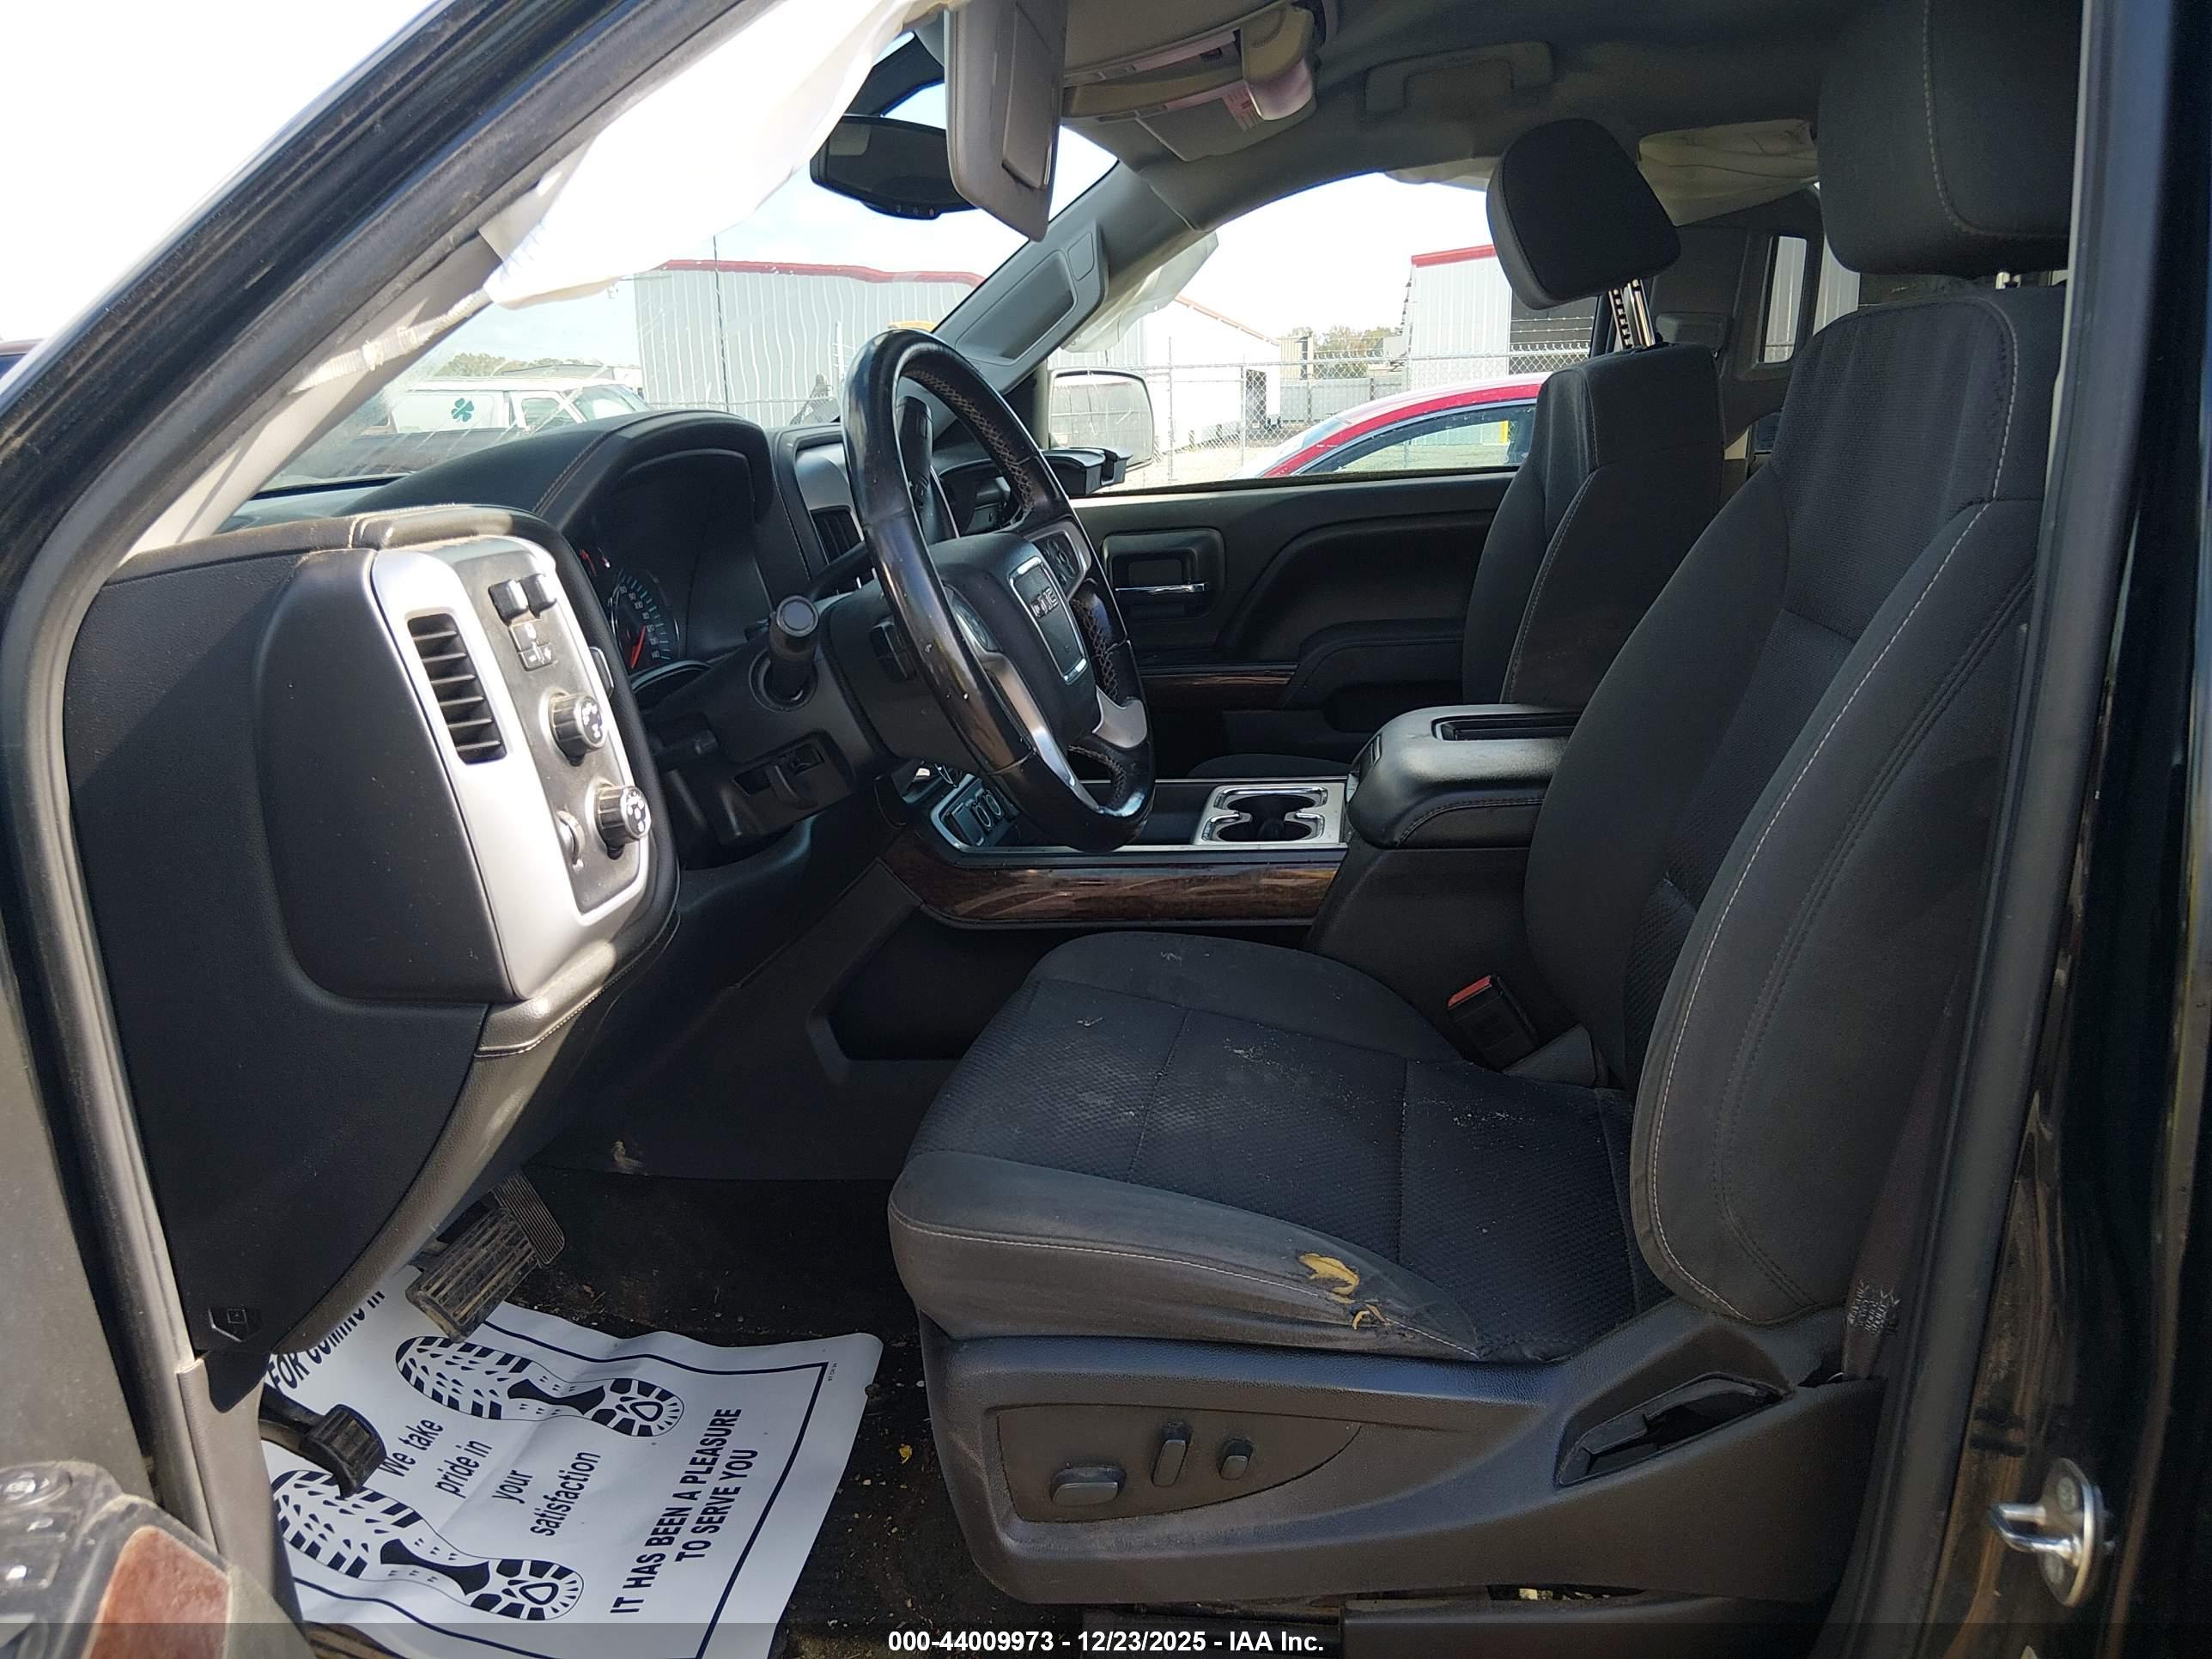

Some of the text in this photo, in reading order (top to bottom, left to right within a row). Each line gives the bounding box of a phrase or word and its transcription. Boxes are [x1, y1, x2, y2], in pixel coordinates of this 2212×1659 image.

[267, 1353, 310, 1389] FOR
[379, 1419, 444, 1478] We take
[434, 1440, 493, 1499] pride in
[492, 1469, 533, 1504] your
[530, 1451, 601, 1536] satisfaction
[610, 1408, 743, 1613] IT HAS BEEN A PLEASURE
[675, 1449, 758, 1562] TO SERVE YOU
